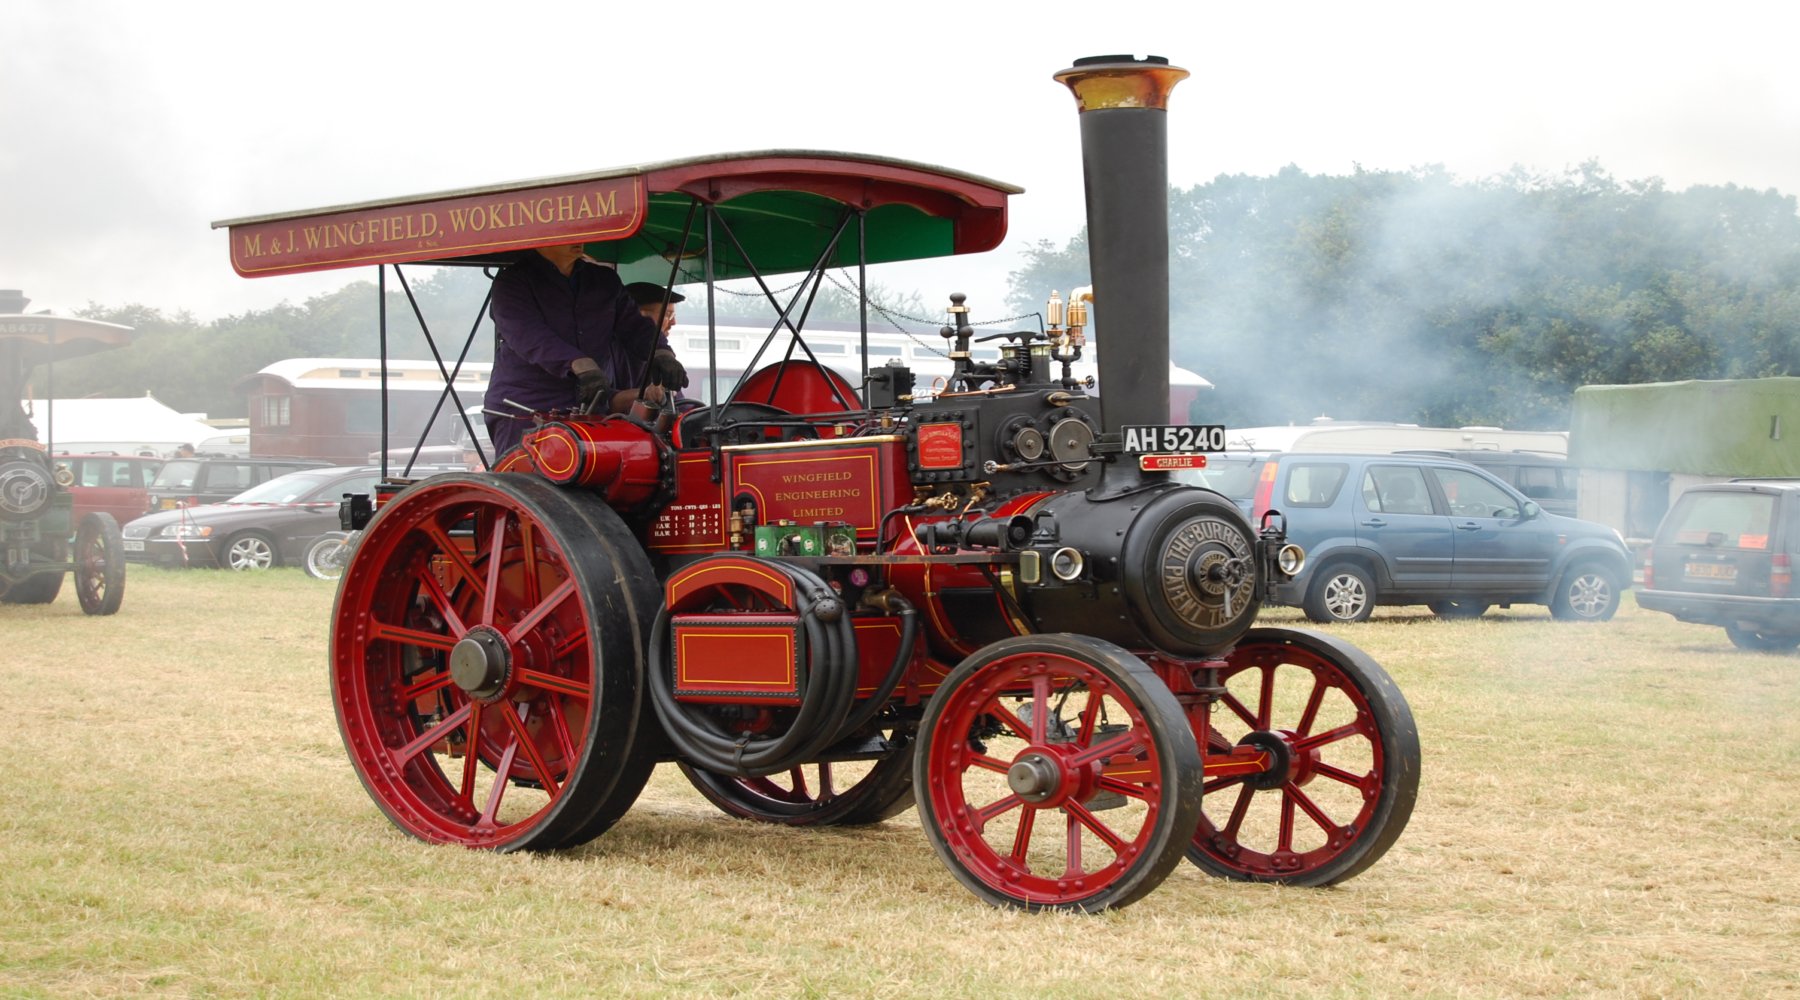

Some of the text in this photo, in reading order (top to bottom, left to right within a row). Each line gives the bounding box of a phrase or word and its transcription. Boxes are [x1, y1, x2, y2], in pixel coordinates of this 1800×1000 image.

[244, 190, 624, 258] M. & J. WINGFIELD, WOKINGHAM.
[1125, 428, 1158, 451] AH
[1163, 427, 1225, 451] 5240
[1156, 458, 1193, 468] CHARLIE
[782, 472, 852, 483] WINGFIELD
[775, 488, 860, 501] ENGINEERING
[793, 507, 844, 518] LIMITED
[1167, 531, 1196, 562] THE
[1165, 565, 1205, 622] PATENT
